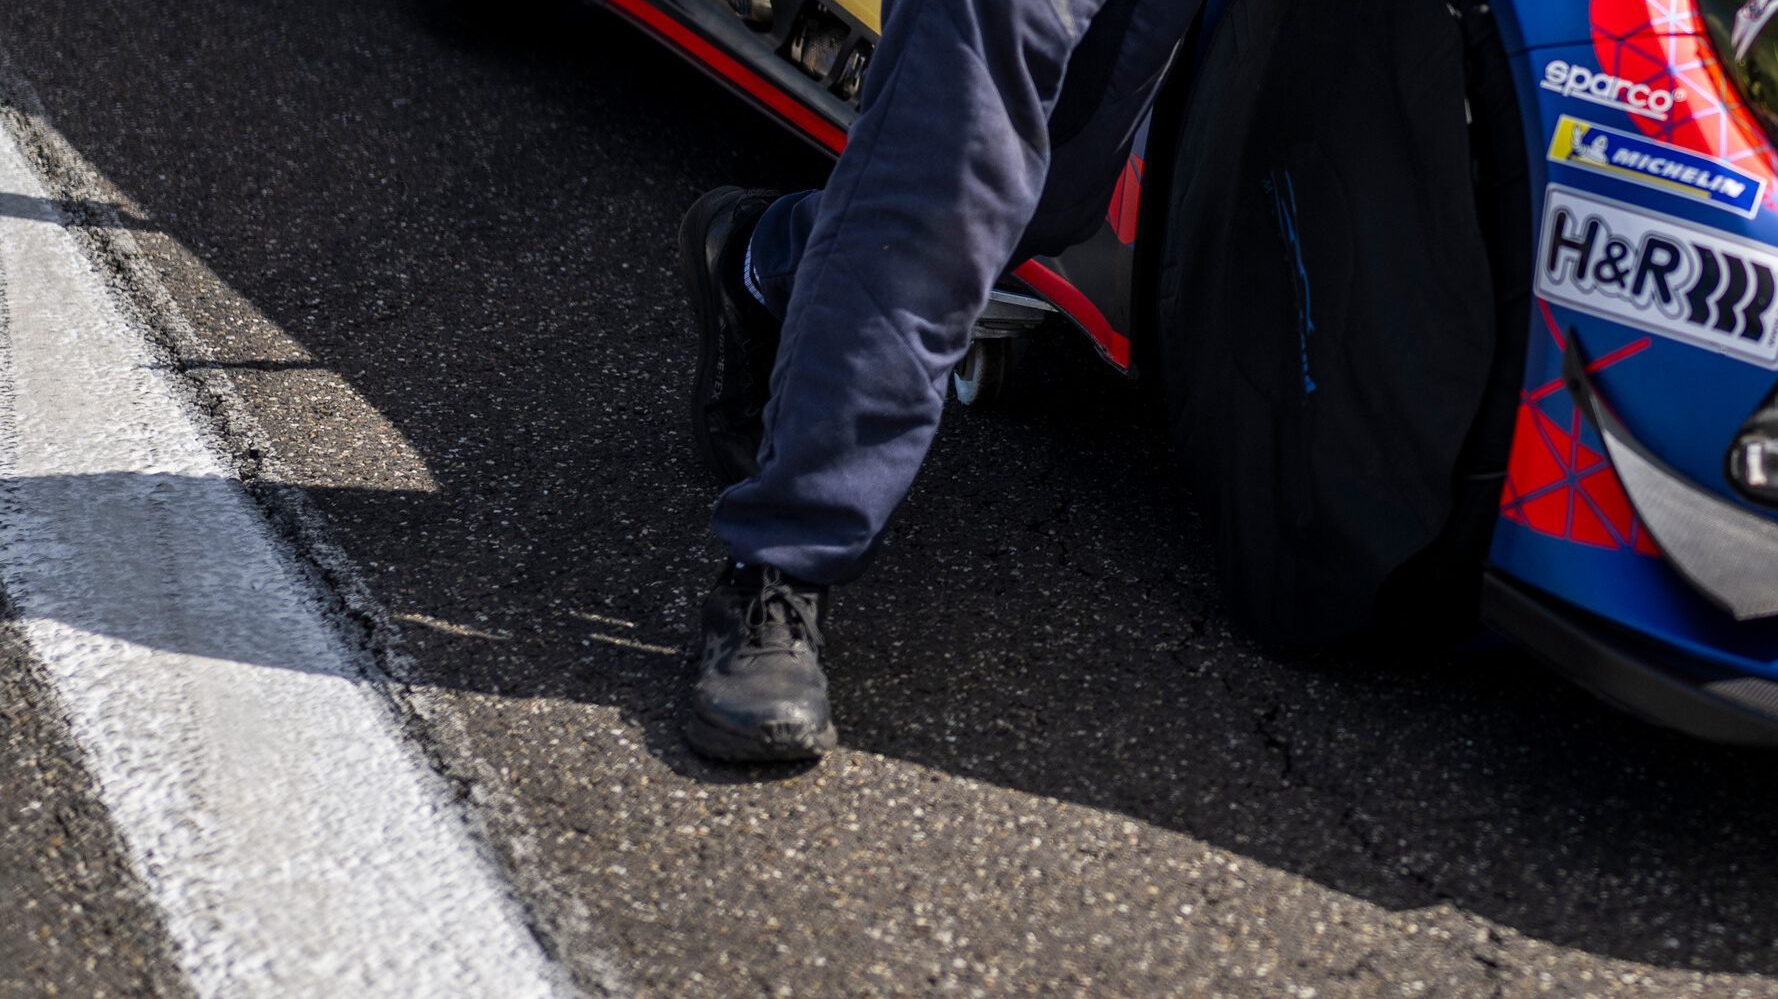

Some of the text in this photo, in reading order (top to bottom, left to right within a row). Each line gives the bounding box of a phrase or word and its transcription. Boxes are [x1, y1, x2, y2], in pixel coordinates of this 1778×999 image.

[1544, 60, 1674, 113] sparco
[1611, 146, 1747, 199] MICHELIN
[1548, 210, 1682, 306] H&R
